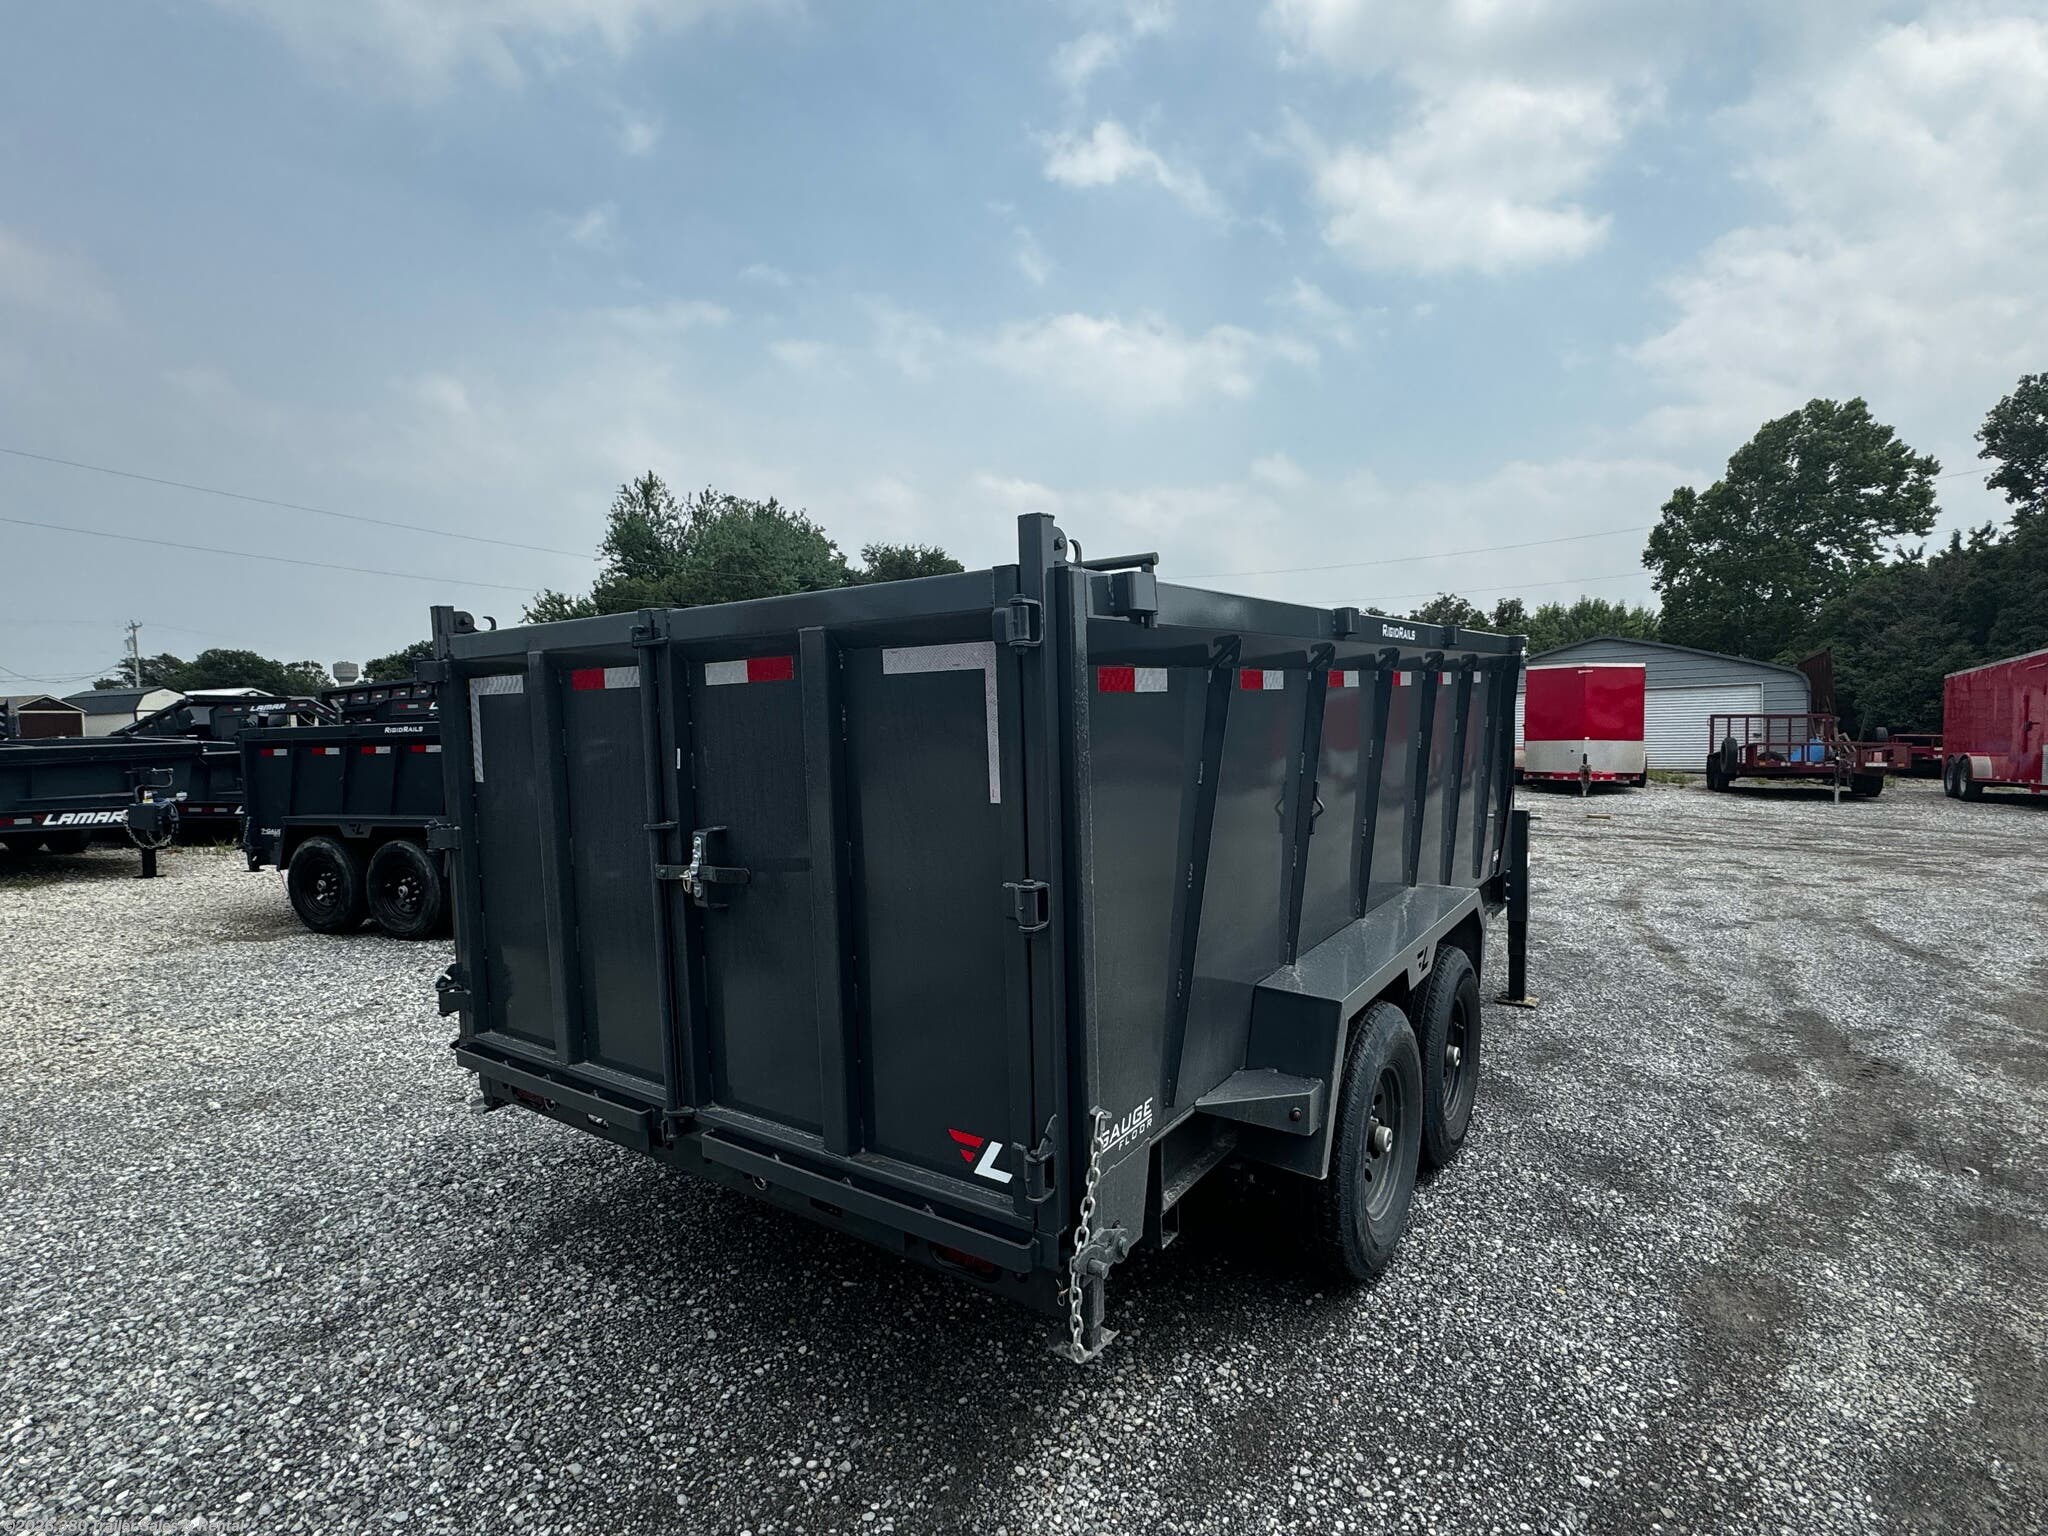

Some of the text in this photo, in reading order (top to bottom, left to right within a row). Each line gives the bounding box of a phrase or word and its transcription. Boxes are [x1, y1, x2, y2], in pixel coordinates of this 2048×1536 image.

[250, 703, 287, 711] LAMAR
[42, 811, 128, 826] LAMAR
[1118, 1117, 1153, 1151] FLOOR
